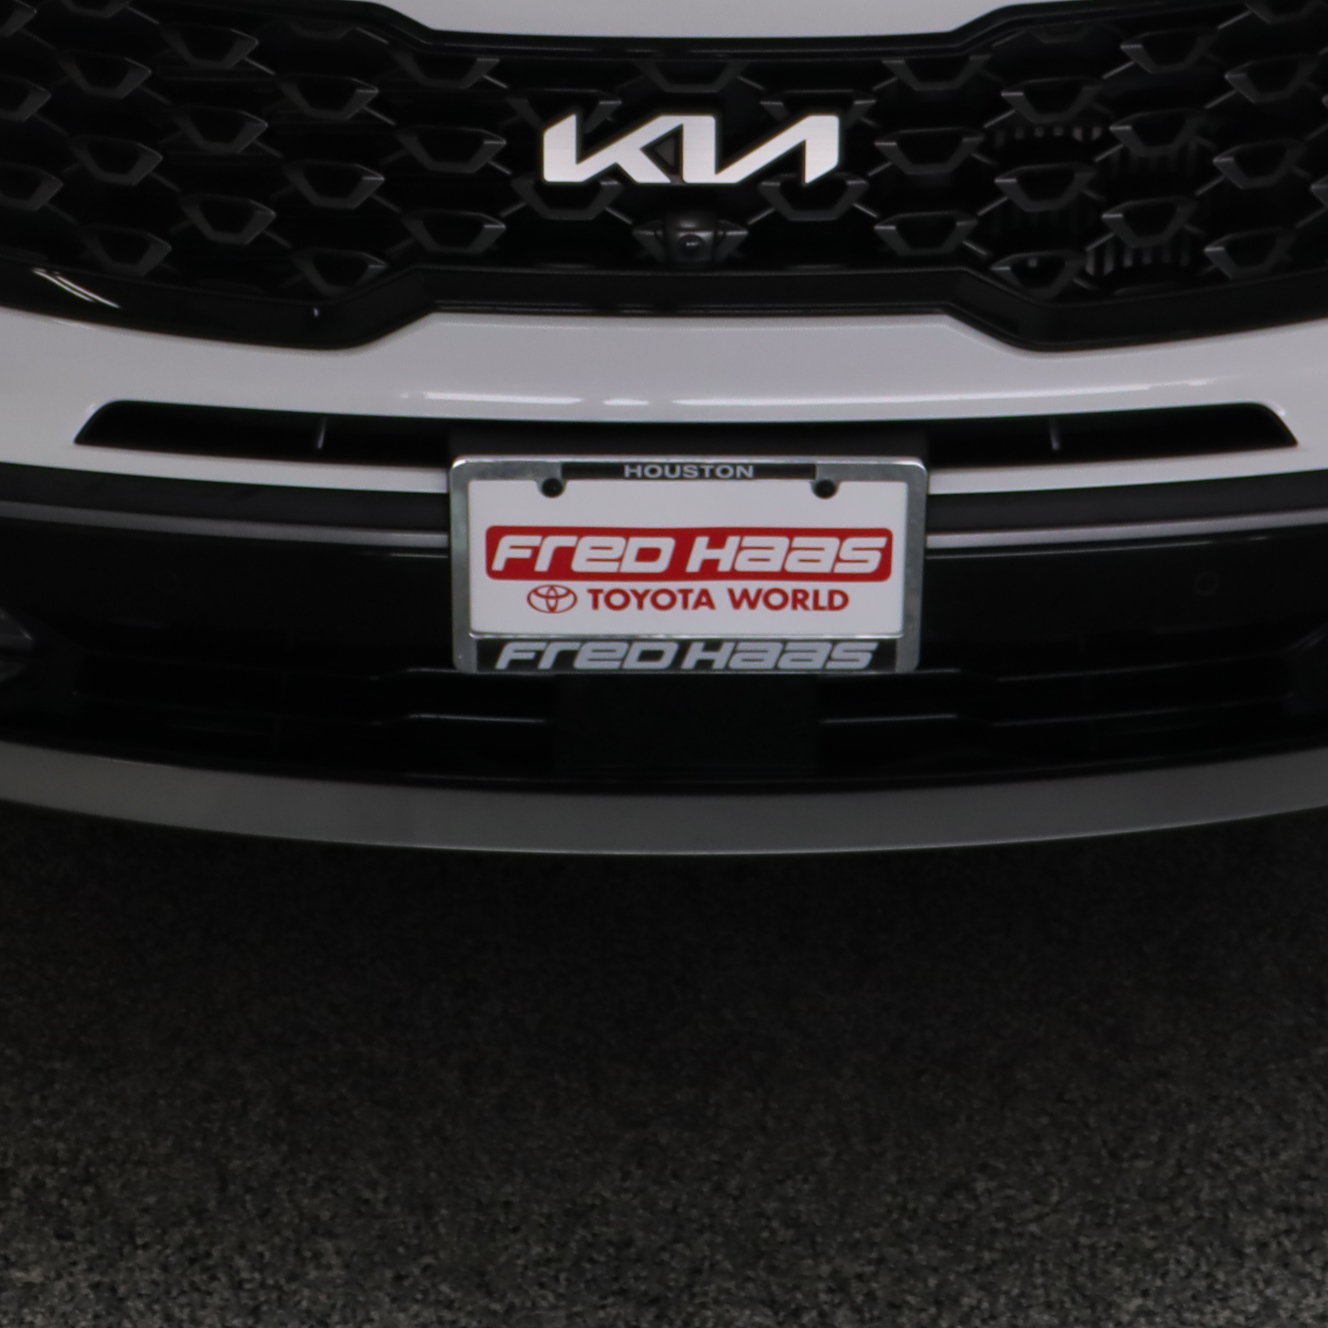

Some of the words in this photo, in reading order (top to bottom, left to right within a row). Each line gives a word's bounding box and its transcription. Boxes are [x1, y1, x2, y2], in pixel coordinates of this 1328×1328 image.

[543, 114, 840, 184] KIA
[623, 464, 755, 479] HOUSTON
[587, 588, 716, 611] TOYOTA
[727, 588, 850, 612] WORLD
